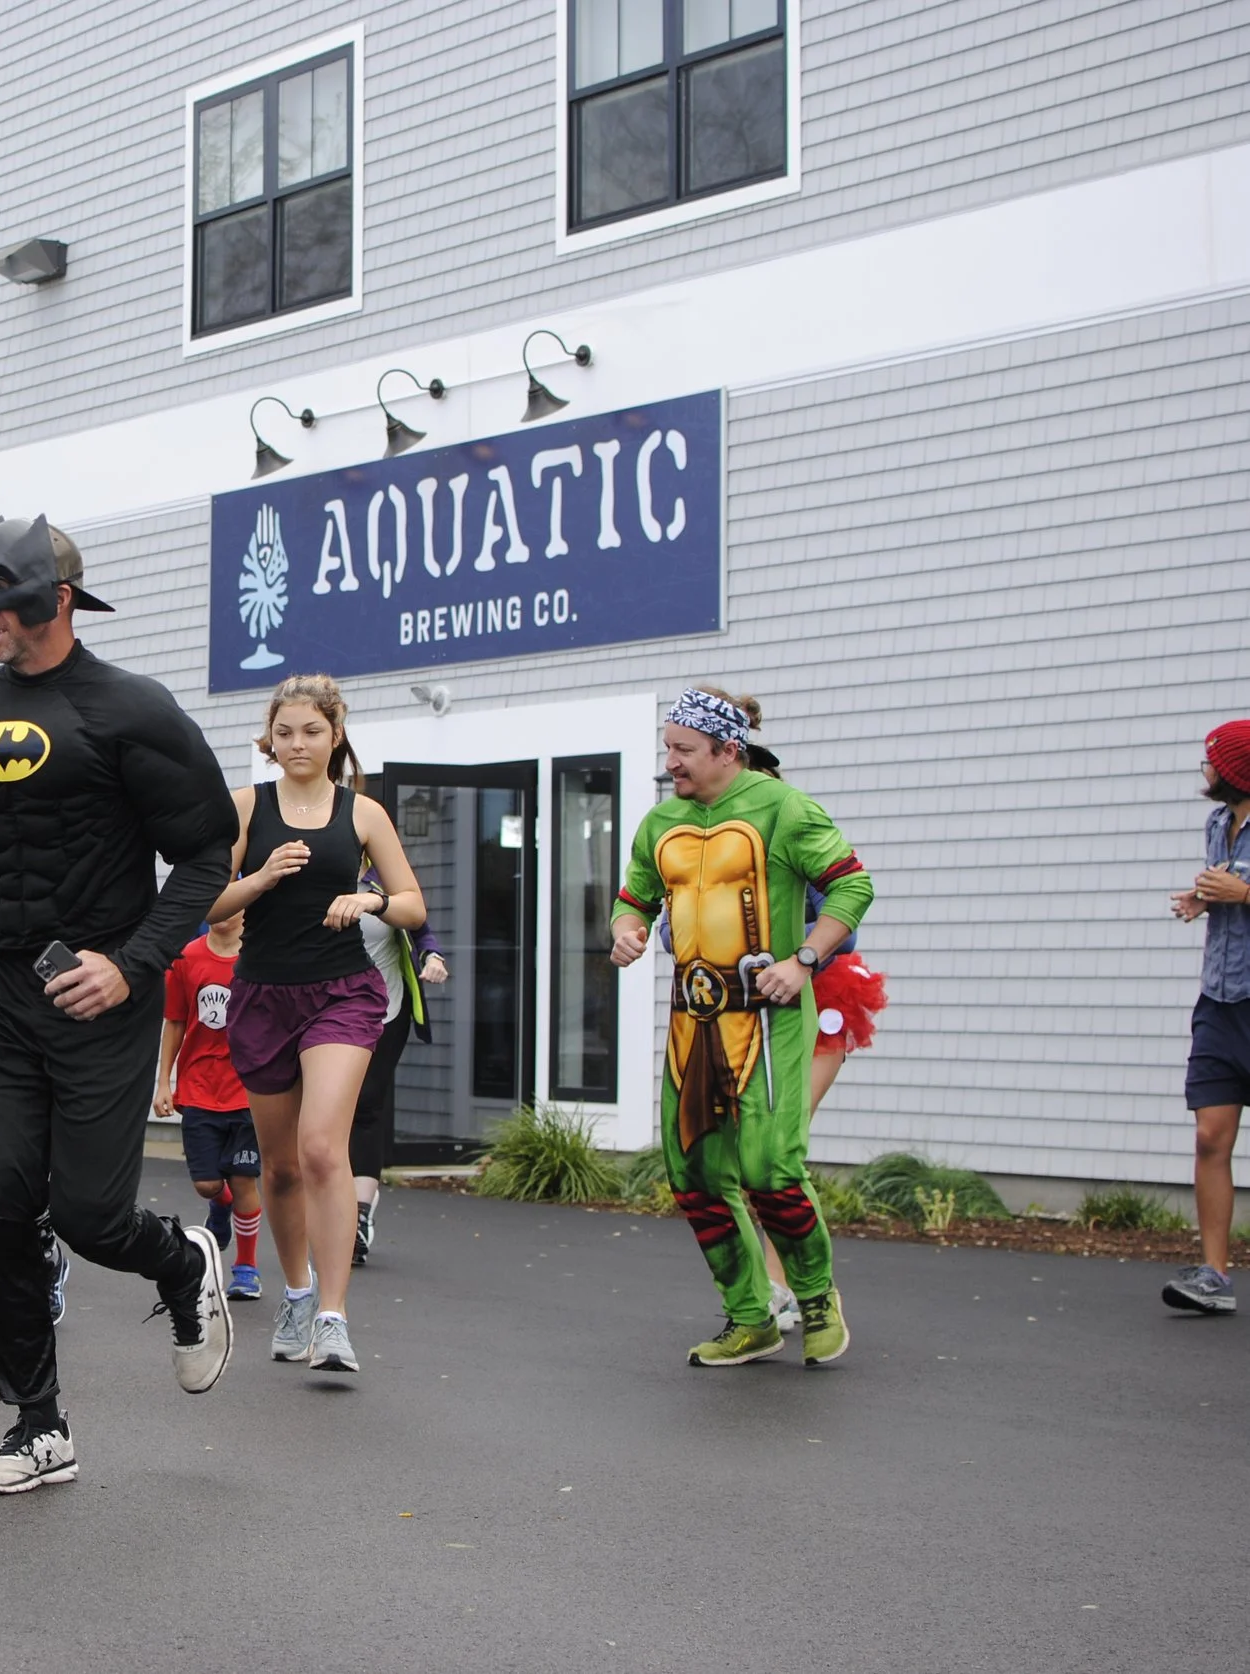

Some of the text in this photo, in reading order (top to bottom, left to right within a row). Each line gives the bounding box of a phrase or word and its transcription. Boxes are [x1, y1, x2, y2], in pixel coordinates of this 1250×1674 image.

[312, 429, 687, 599] AQUATIC
[400, 588, 578, 646] BREWING CO.
[200, 991, 229, 1008] THIN
[691, 975, 715, 1005] R
[208, 1010, 220, 1025] 2
